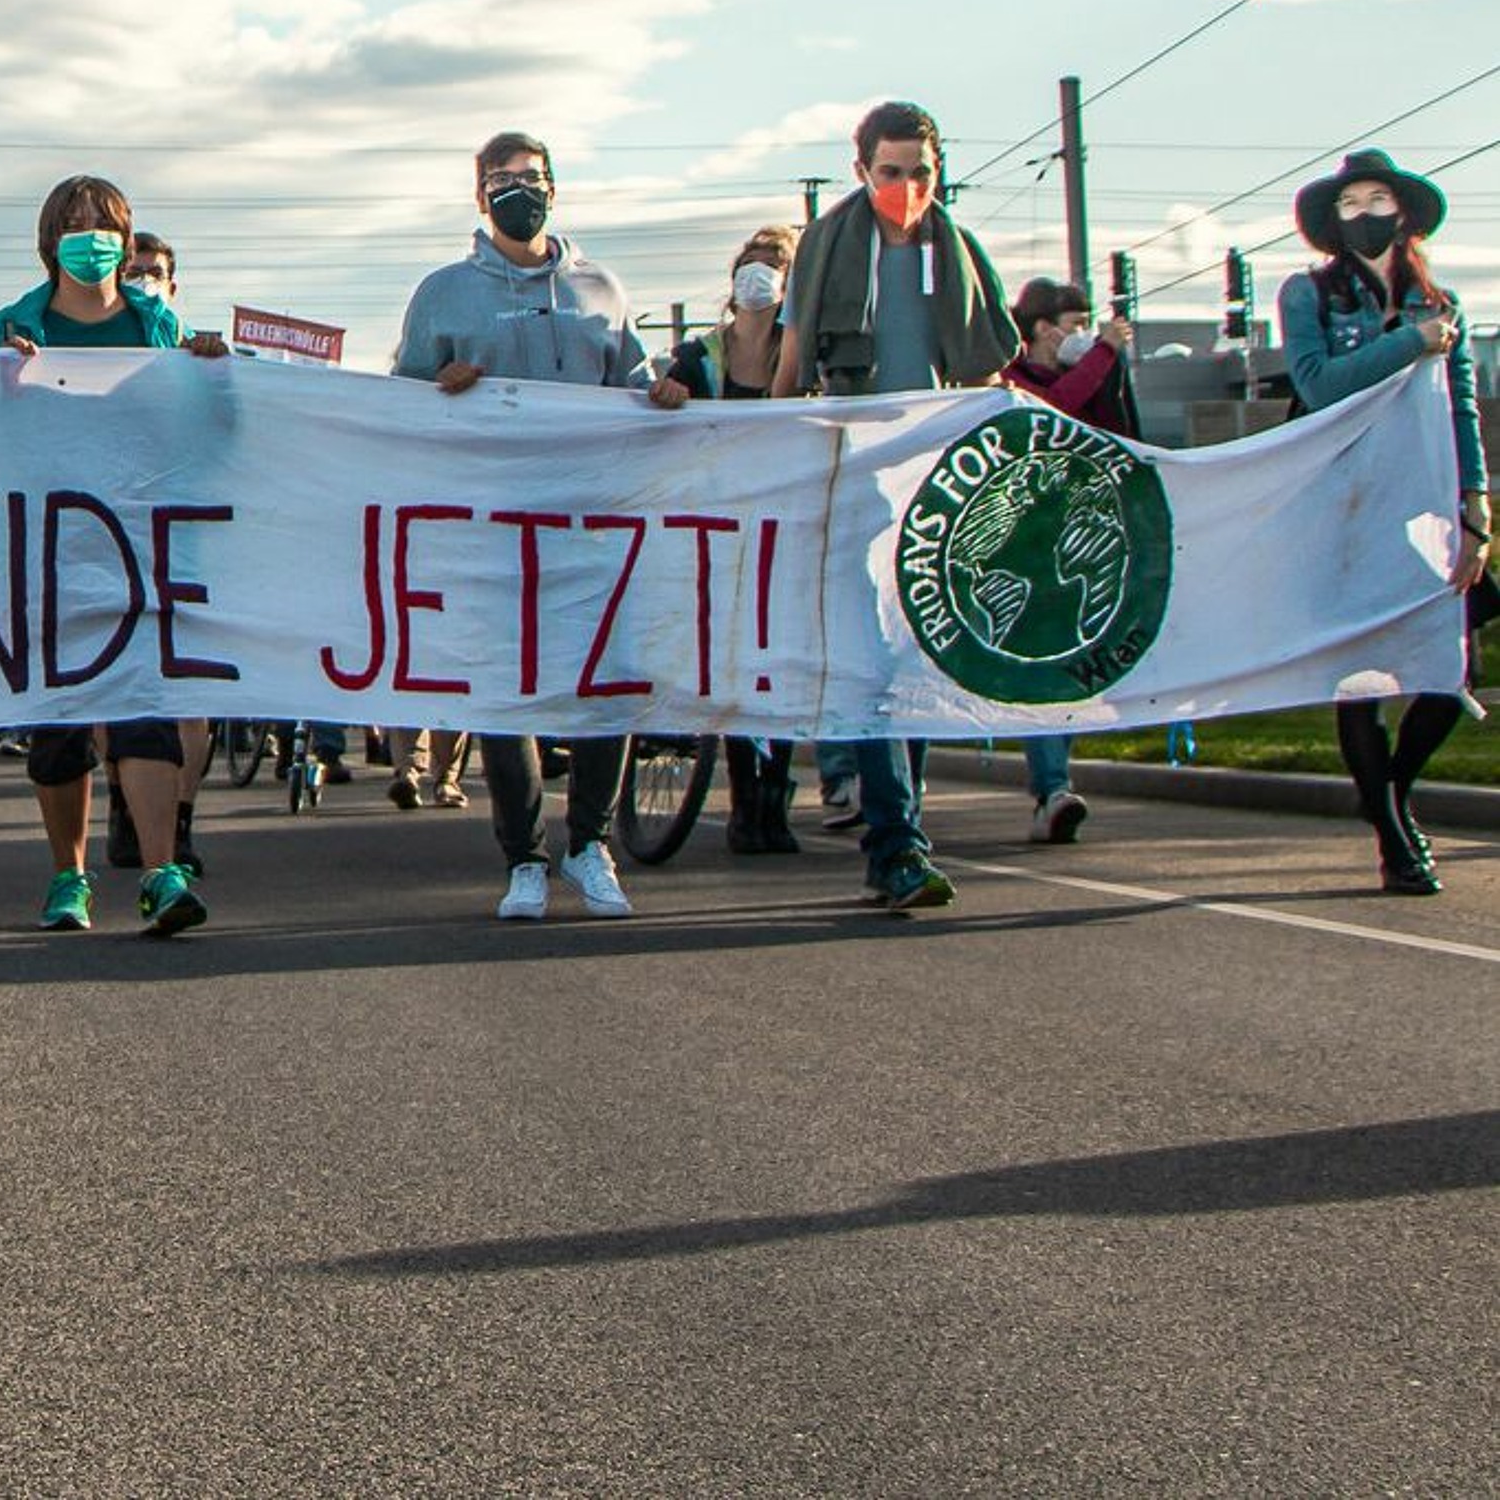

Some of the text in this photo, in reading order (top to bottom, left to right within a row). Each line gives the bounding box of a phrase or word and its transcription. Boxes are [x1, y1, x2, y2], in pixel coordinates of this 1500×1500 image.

[931, 425, 1015, 503] FOR
[321, 504, 778, 697] JETZT!
[902, 503, 962, 654] FRIDAYS
